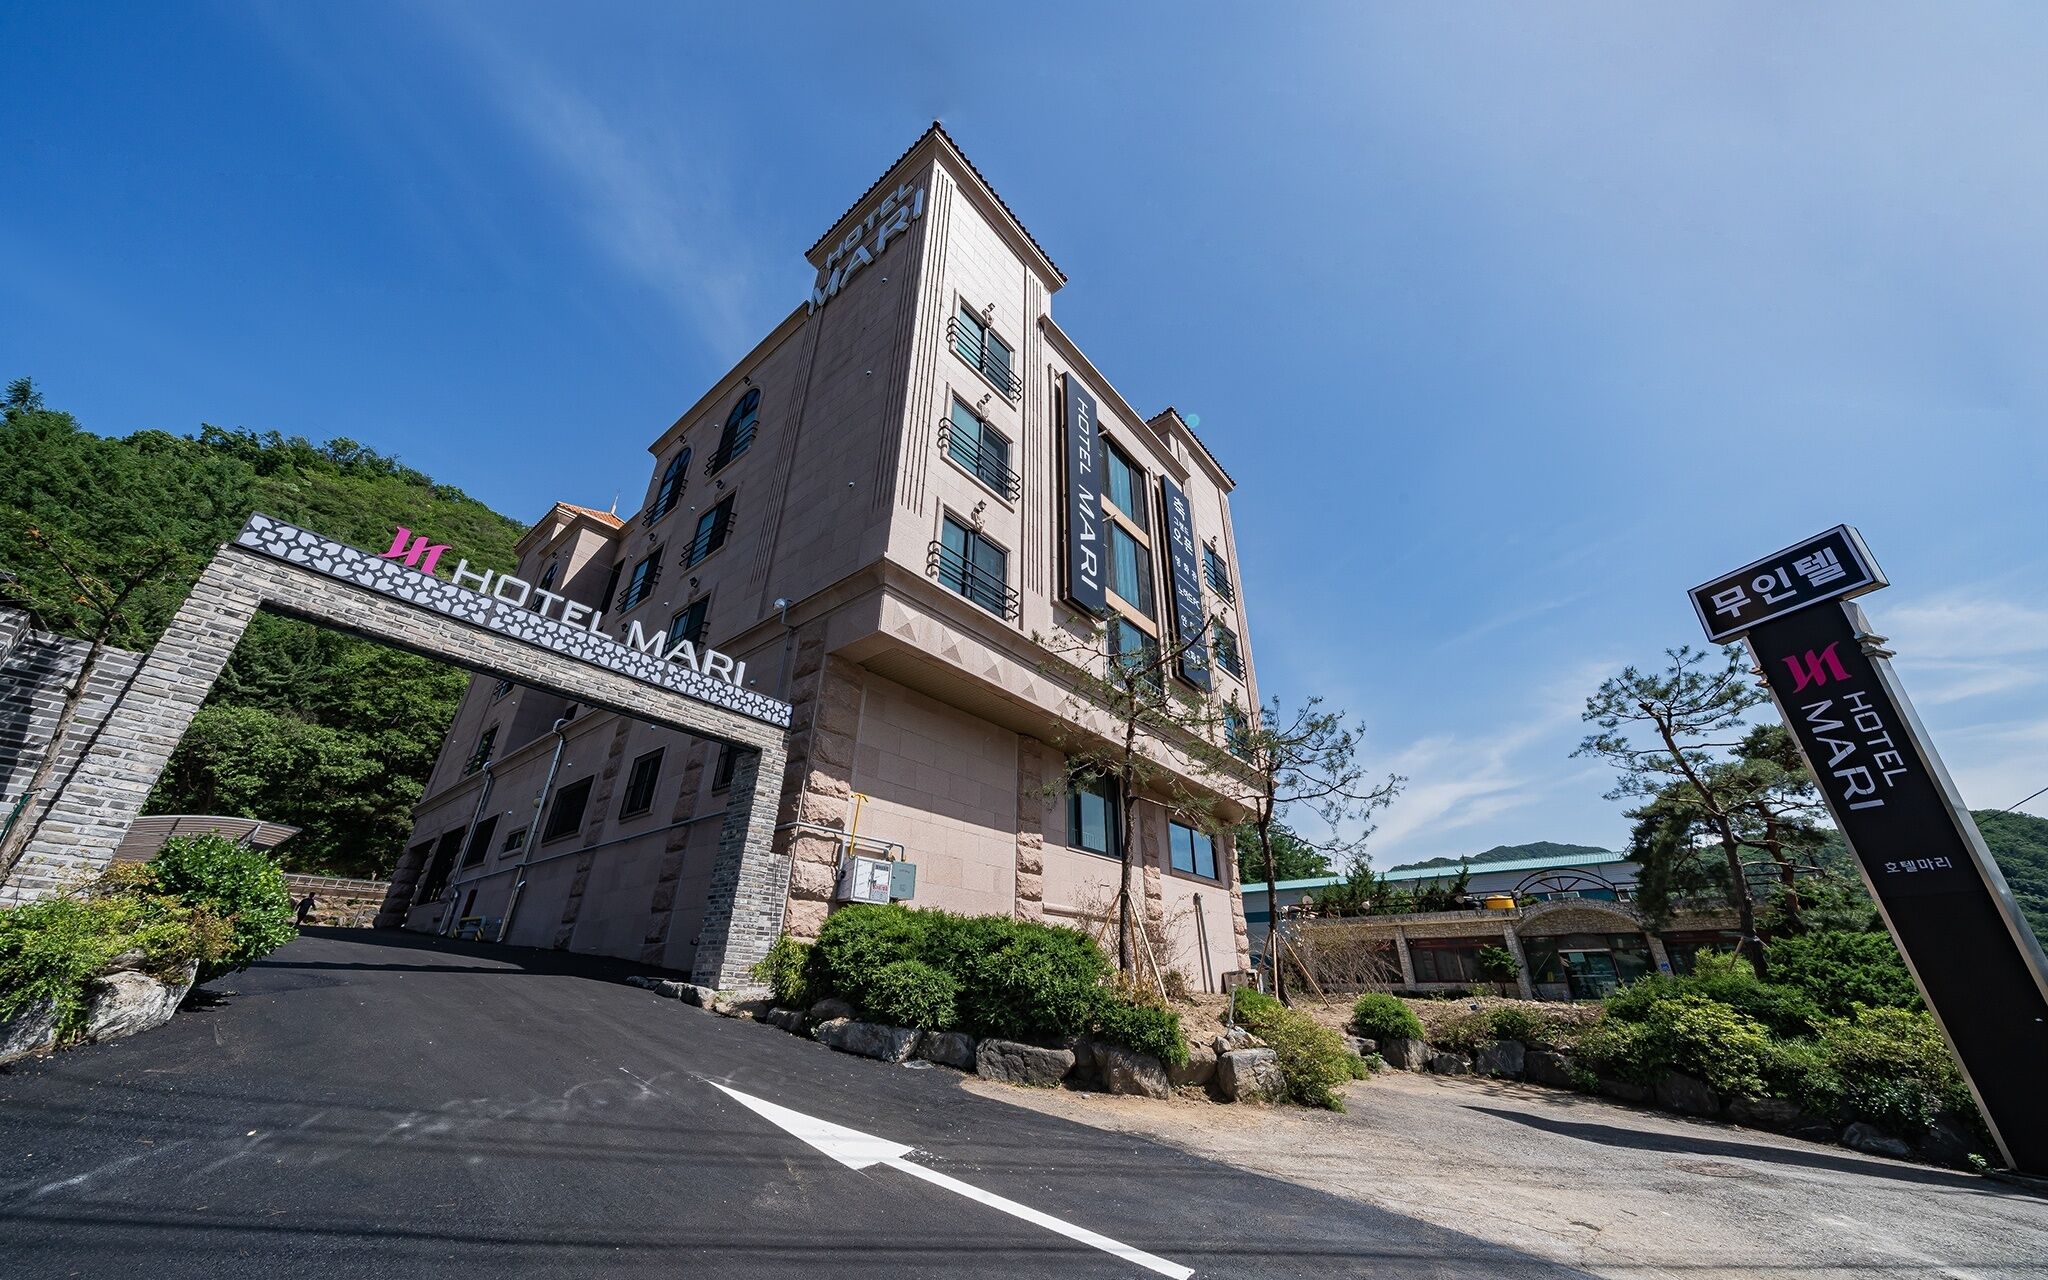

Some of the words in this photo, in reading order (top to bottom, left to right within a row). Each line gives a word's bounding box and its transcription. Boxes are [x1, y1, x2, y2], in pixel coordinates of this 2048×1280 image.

[808, 188, 925, 316] MARI
[826, 184, 914, 269] HOTEL
[1077, 396, 1092, 475] HOTEL
[1078, 484, 1099, 592] MARI
[1173, 527, 1193, 556] 오픈
[1711, 546, 1847, 618] 무인텔
[452, 558, 614, 641] HOTEL
[627, 620, 746, 687] MARI
[1800, 699, 1885, 811] MARI
[1842, 691, 1908, 788] HOTEL
[1884, 856, 1953, 873] 호텔마리
